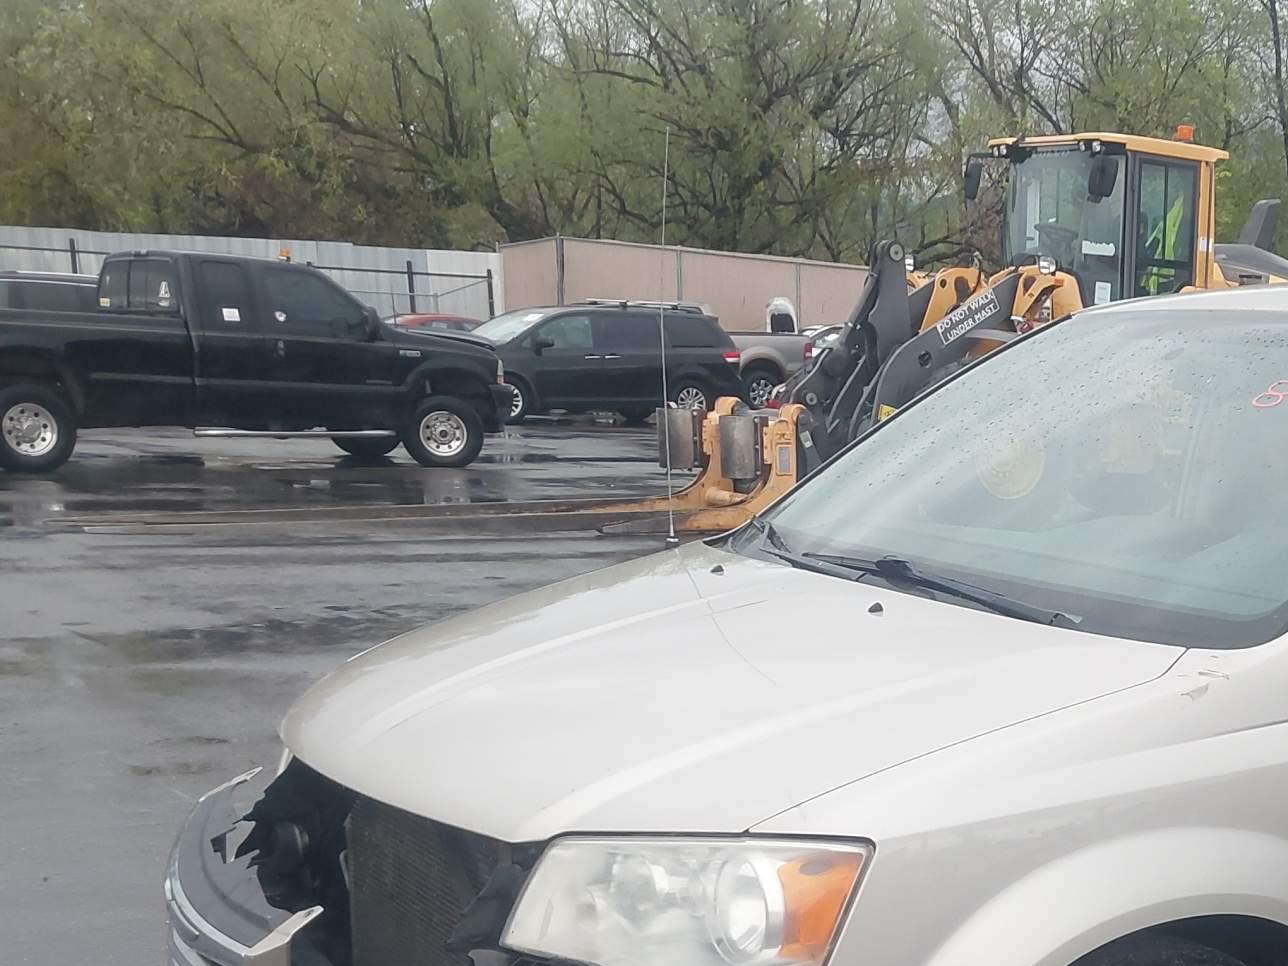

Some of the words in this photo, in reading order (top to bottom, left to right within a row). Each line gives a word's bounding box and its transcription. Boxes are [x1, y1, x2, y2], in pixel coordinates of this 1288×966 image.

[938, 320, 951, 332] DO
[951, 307, 969, 323] NOT
[969, 291, 994, 310] WALK
[947, 318, 974, 339] UNDER
[974, 303, 995, 324] MAST
